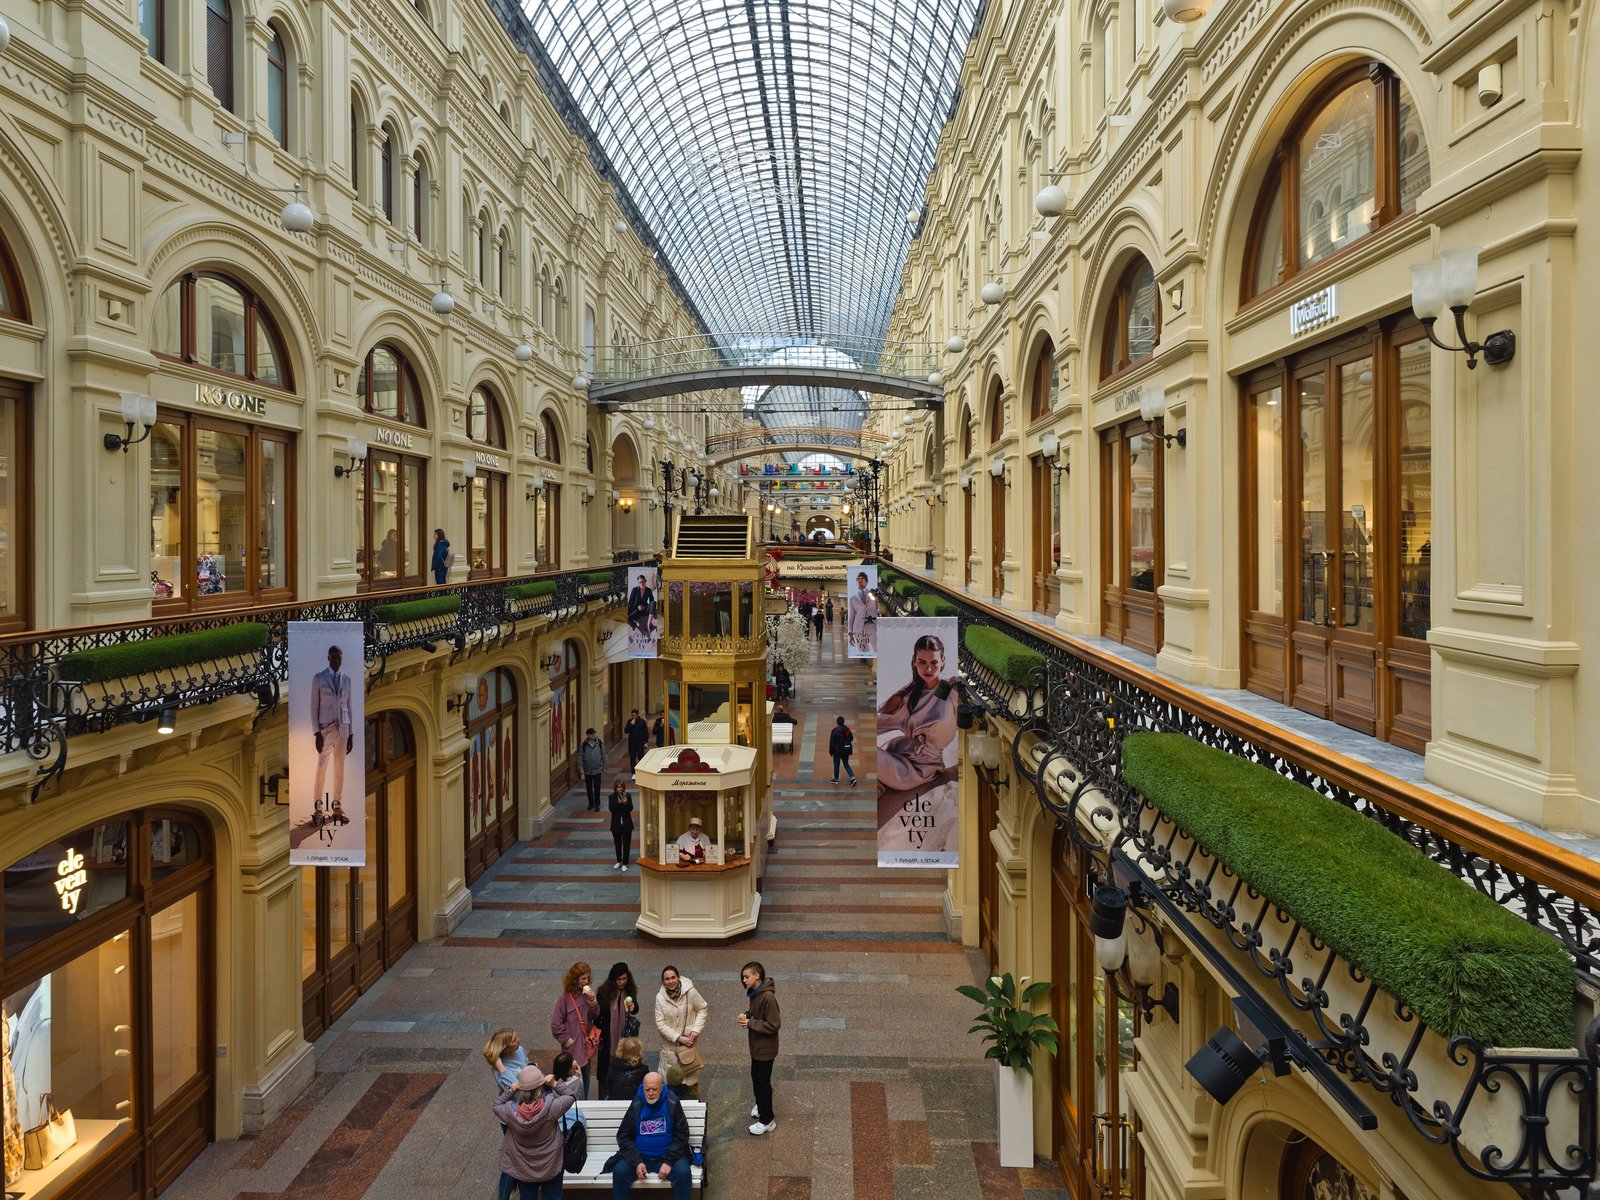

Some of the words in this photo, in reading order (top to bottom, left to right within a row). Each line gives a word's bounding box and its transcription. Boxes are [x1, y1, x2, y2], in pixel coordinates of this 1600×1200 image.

[1297, 296, 1329, 324] Wolford
[195, 384, 227, 406] NO
[227, 391, 267, 417] ONE
[374, 427, 393, 444] NO
[393, 432, 414, 448] ONE
[474, 451, 487, 464] NO
[486, 455, 500, 467] ONE
[796, 563, 824, 572] Красной
[671, 779, 707, 787] Мороженое
[314, 792, 341, 812] ele
[903, 792, 932, 813] ele
[311, 814, 344, 827] ven
[898, 815, 937, 828] ven
[319, 827, 337, 848] ty
[907, 828, 929, 849] ty
[57, 847, 85, 876] ele
[53, 869, 88, 895] ven
[60, 888, 82, 914] ty
